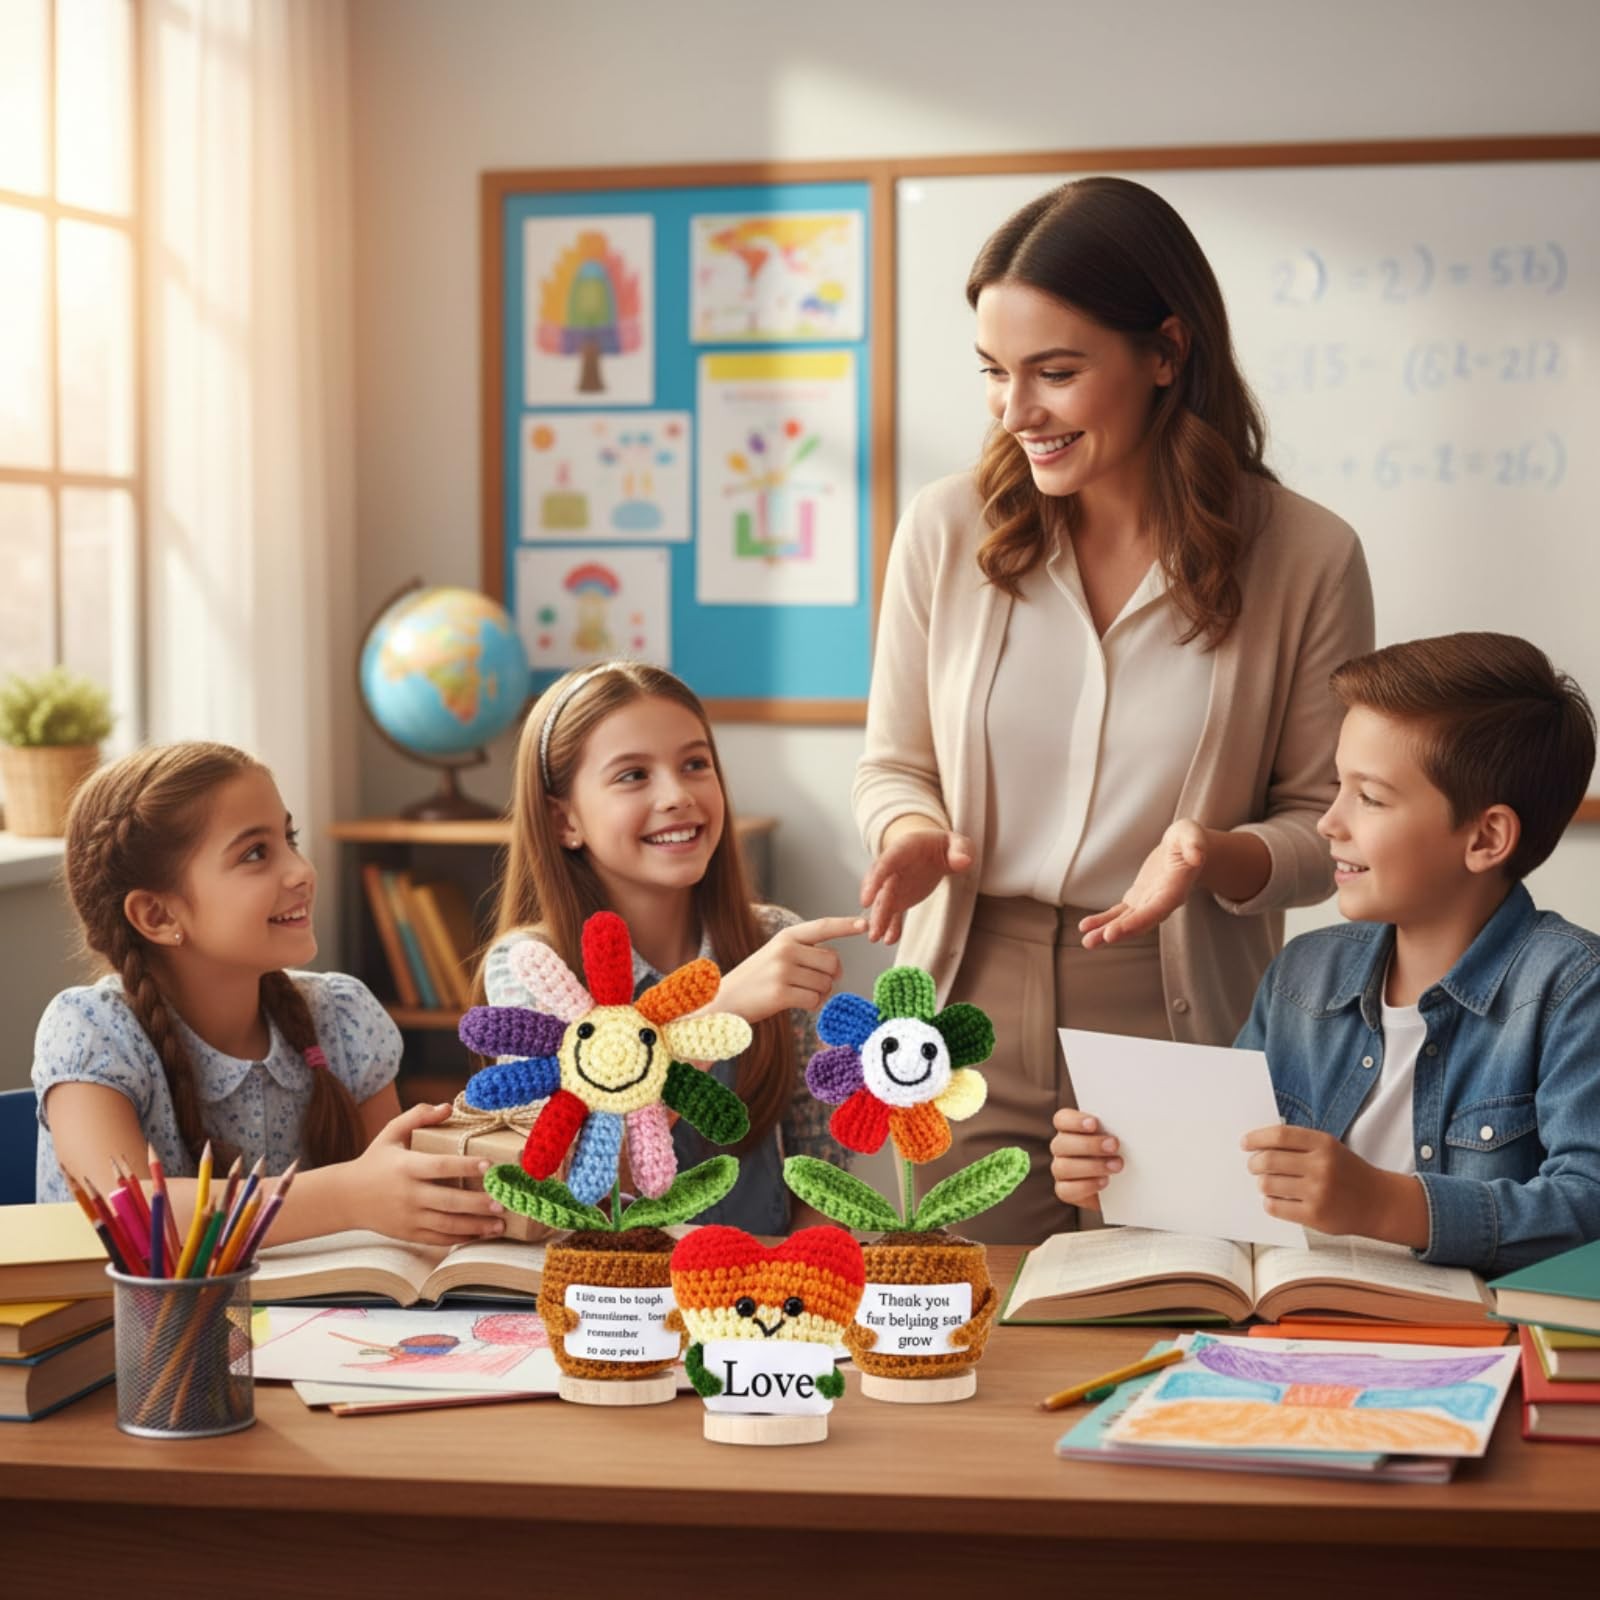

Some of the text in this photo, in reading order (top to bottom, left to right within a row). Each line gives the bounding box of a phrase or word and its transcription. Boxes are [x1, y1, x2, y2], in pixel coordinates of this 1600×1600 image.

[925, 1297, 950, 1311] you
[898, 1336, 932, 1349] grow
[721, 1360, 815, 1399] Love
